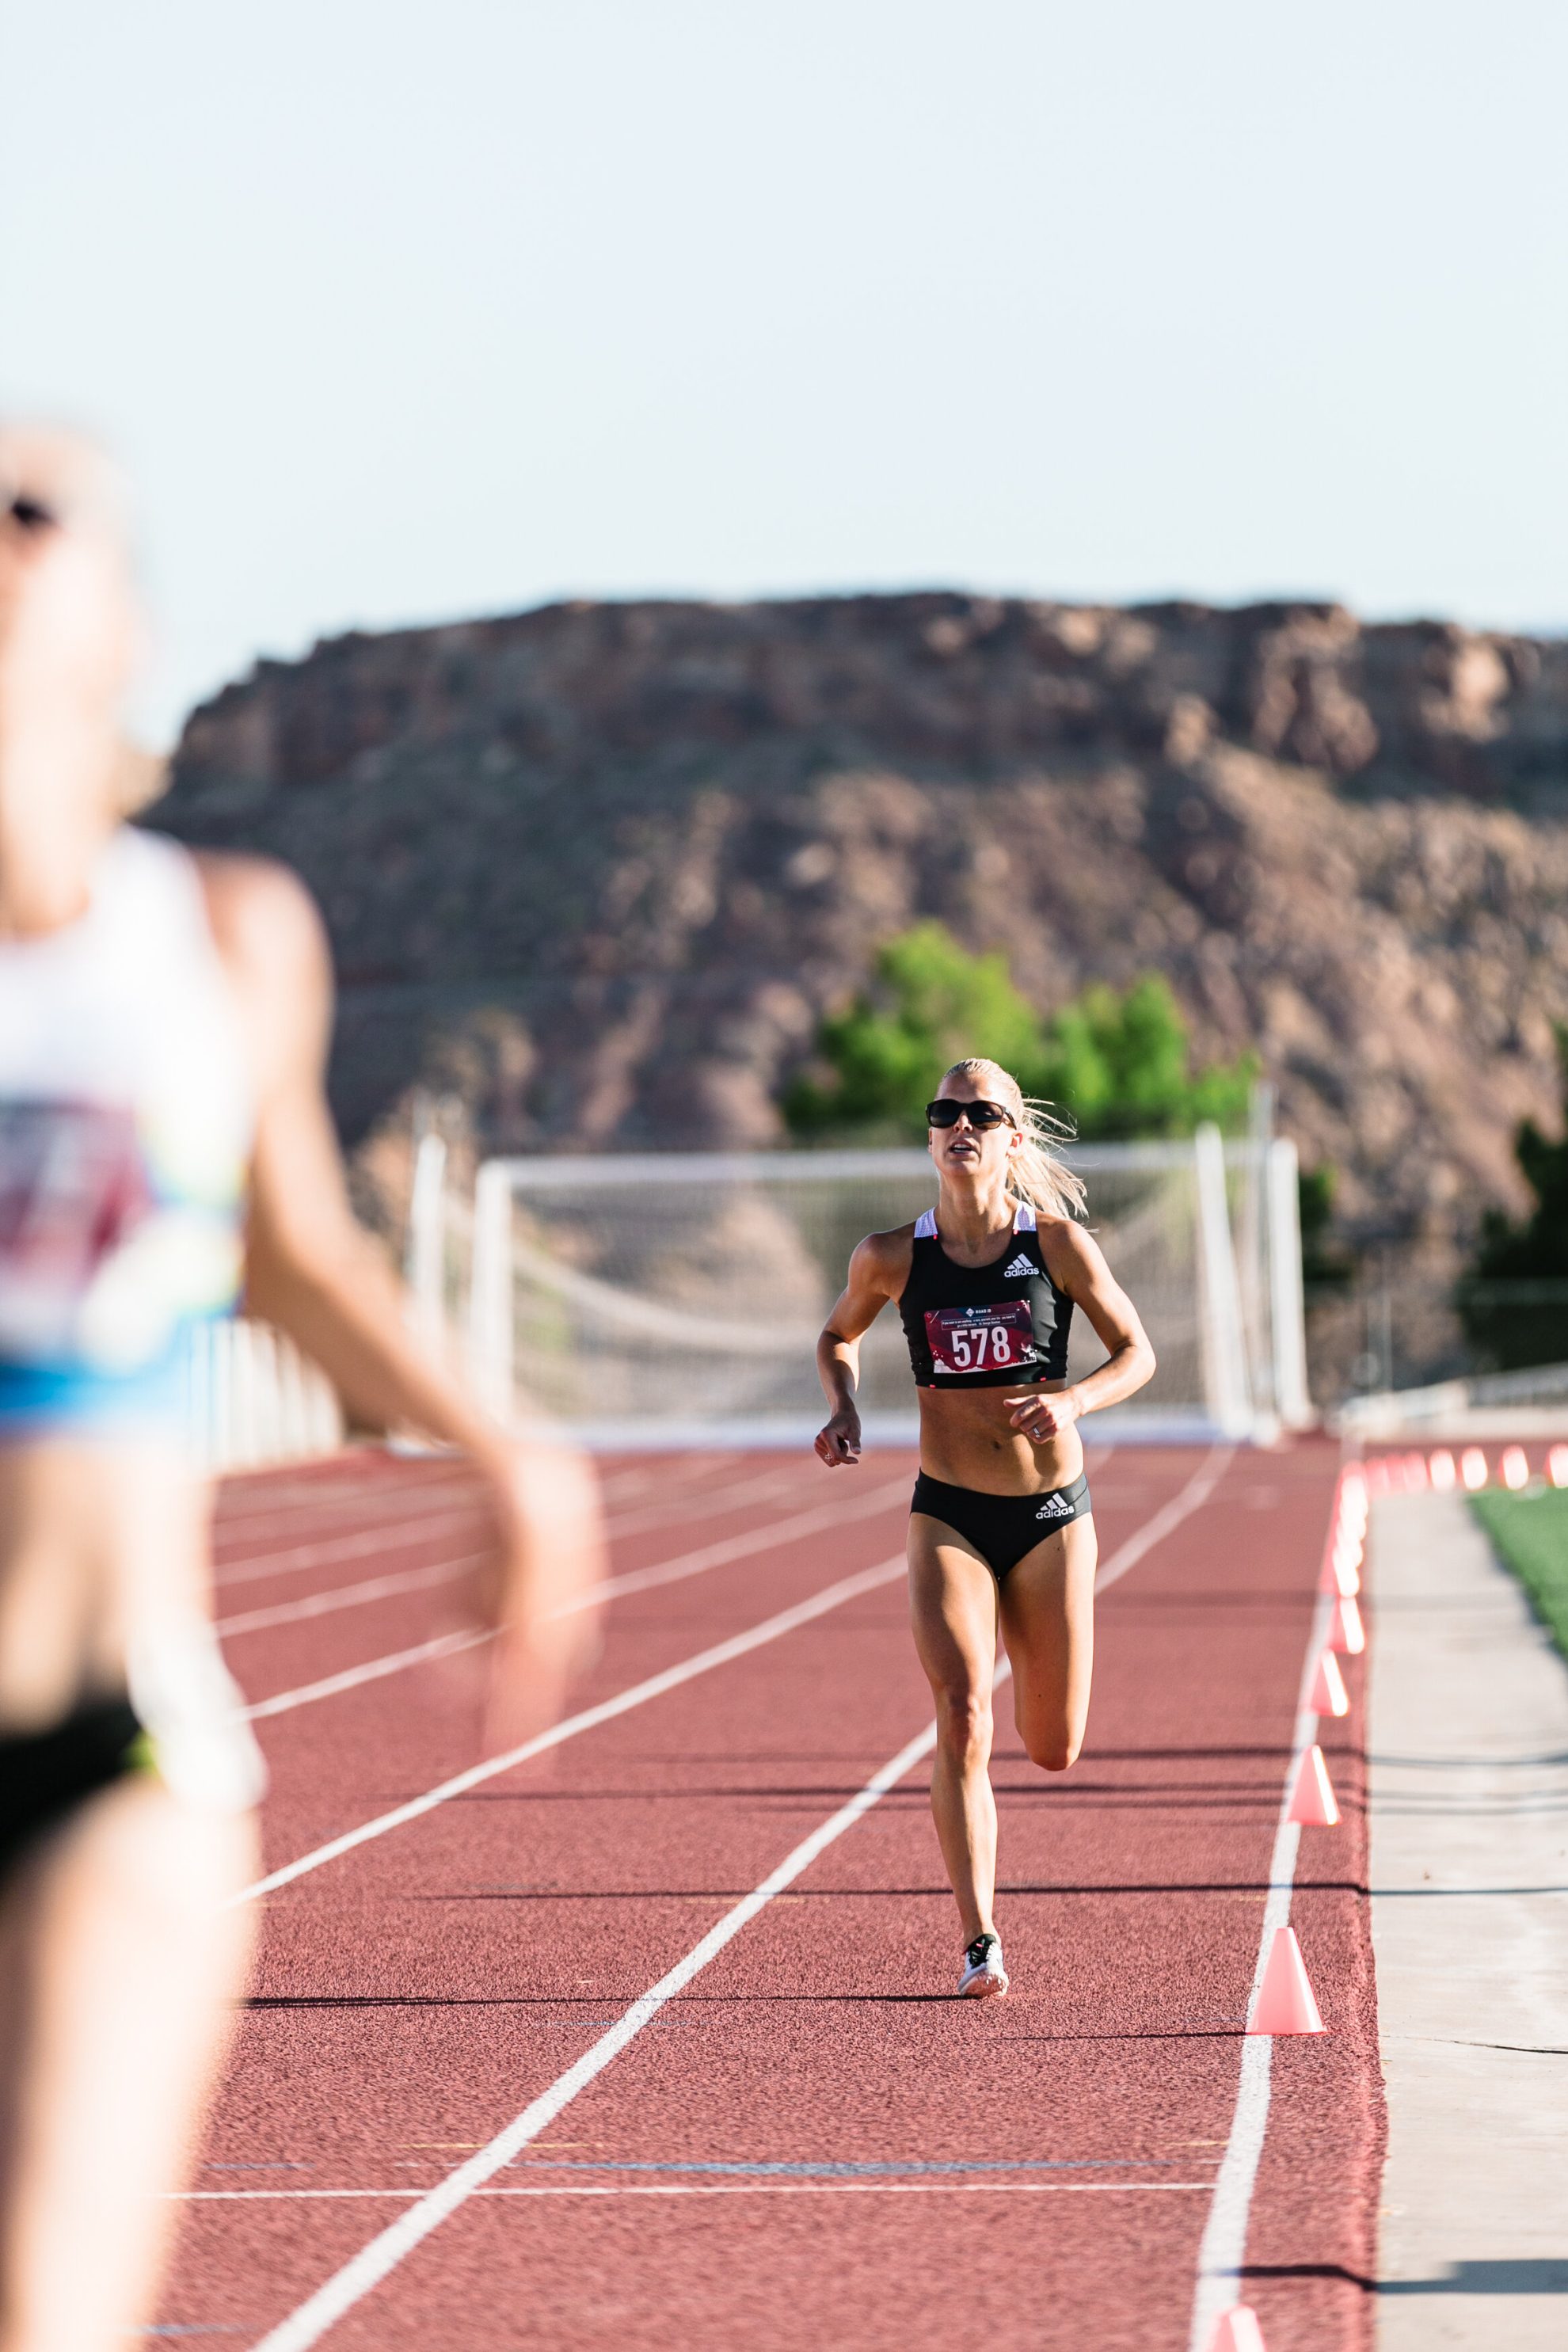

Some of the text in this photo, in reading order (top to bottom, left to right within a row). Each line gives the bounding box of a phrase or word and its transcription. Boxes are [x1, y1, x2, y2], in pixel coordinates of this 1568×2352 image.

[1004, 1267, 1039, 1277] adidas
[951, 1326, 1010, 1367] 578
[1036, 1505, 1075, 1519] adidas
